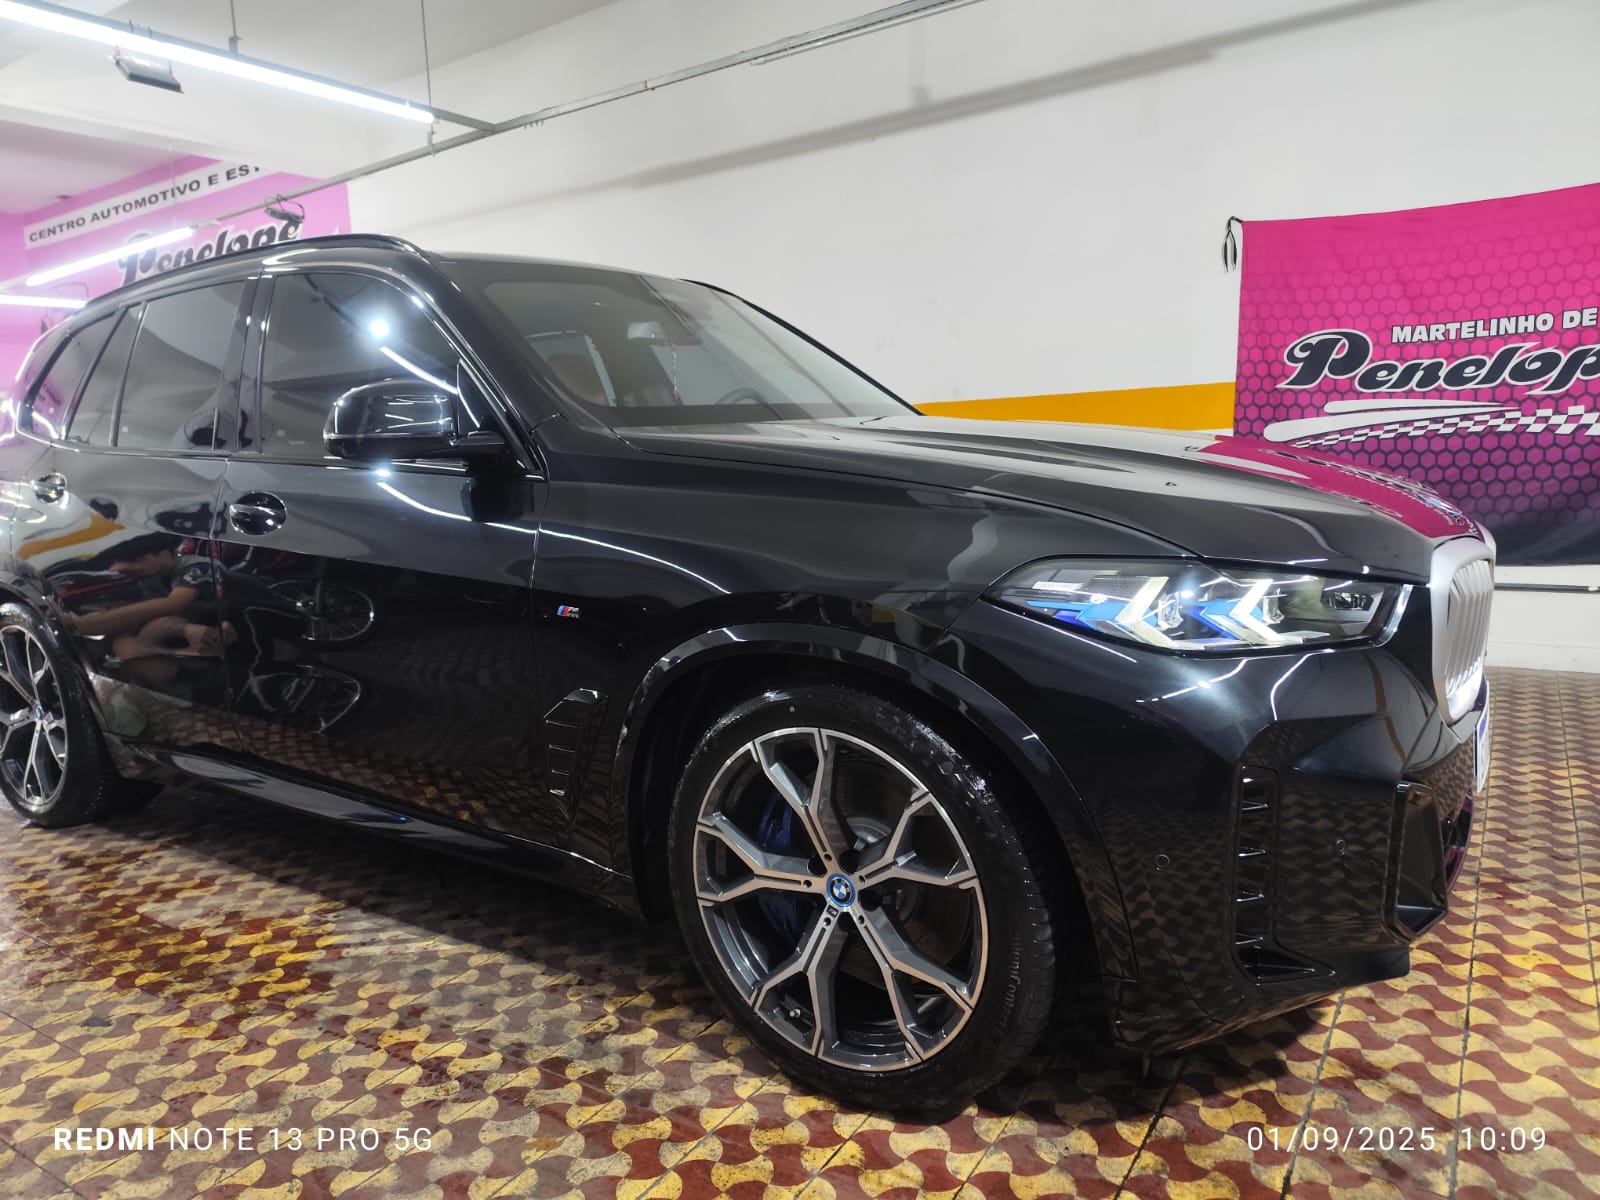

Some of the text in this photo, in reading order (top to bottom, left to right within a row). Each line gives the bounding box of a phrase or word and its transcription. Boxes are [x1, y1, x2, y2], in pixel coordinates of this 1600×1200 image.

[29, 217, 86, 243] CENTRO
[90, 180, 201, 223] AUTOMOTIVO
[207, 174, 219, 186] E
[1391, 307, 1598, 343] MARTELINHO DE
[1275, 328, 1600, 395] Penelop
